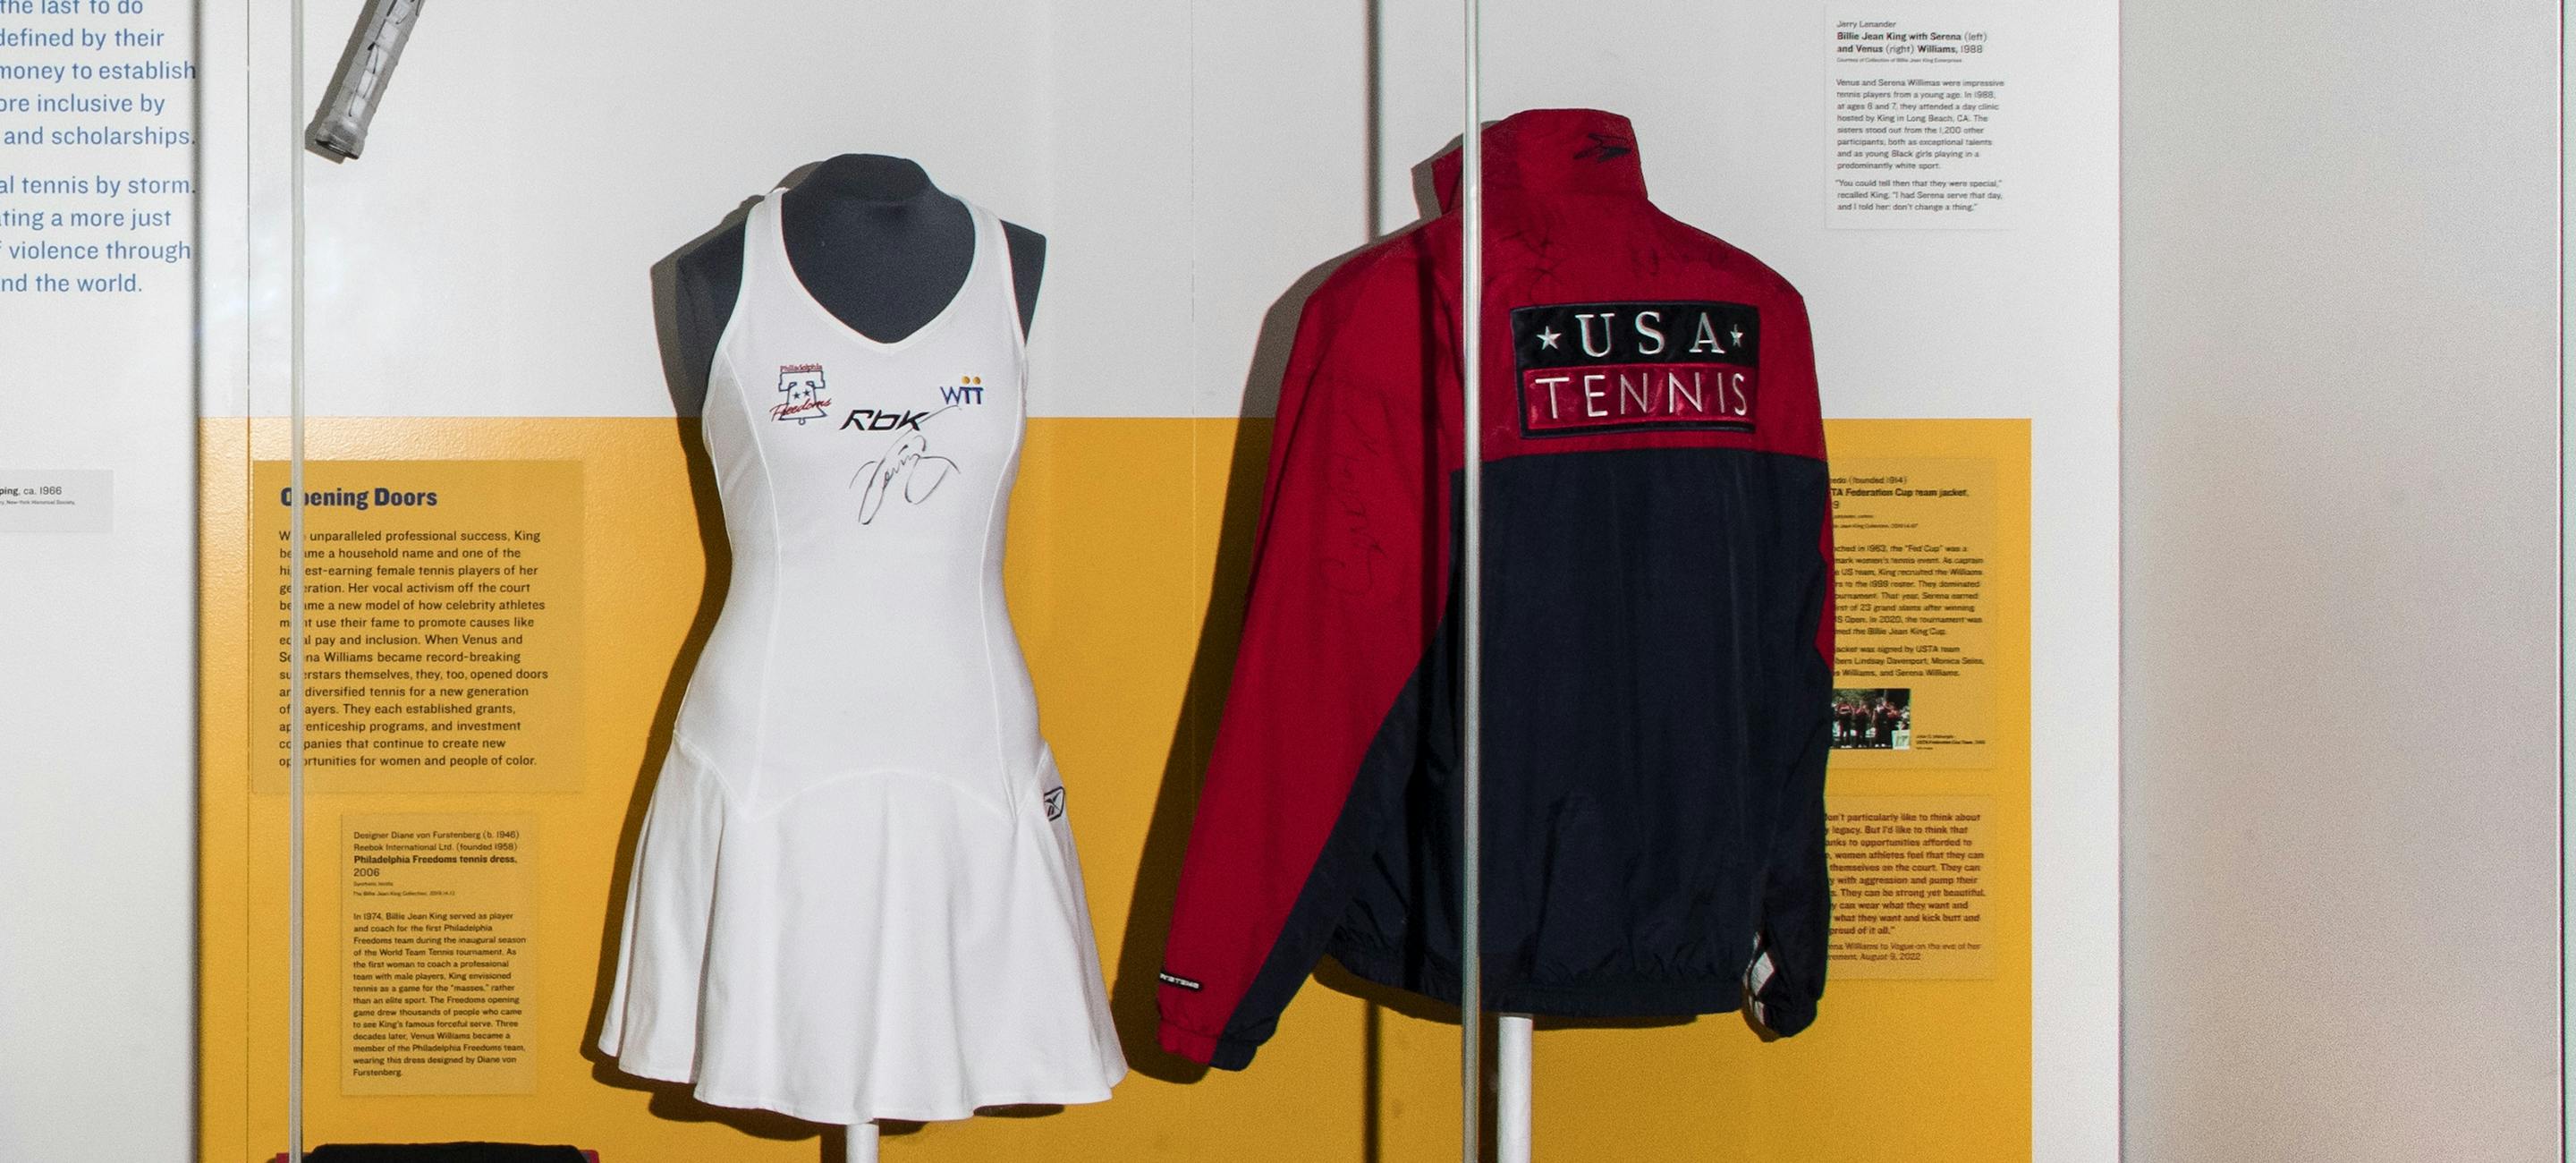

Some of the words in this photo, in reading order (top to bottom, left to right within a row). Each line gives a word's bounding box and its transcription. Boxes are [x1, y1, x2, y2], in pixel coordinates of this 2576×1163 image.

[0, 0, 33, 14] the
[42, 0, 80, 14] last
[89, 0, 110, 14] to
[118, 0, 143, 14] do
[82, 28, 106, 51] by
[114, 28, 165, 47] their
[1837, 31, 1860, 40] Billie
[1861, 32, 1884, 40] Jean
[1886, 32, 1907, 43] King
[1909, 32, 1928, 40] with
[1930, 32, 1962, 40] Serena
[1964, 32, 1987, 42] (left)
[1837, 45, 1853, 53] and
[1855, 45, 1883, 53] Venus
[1885, 45, 1914, 54] (right)
[1917, 45, 1958, 54] Williams,
[1961, 45, 1983, 54] 1988
[72, 64, 92, 80] to
[99, 62, 196, 80] establish
[0, 98, 30, 112] ore
[38, 93, 132, 112] inclusive
[140, 93, 165, 116] by
[4, 126, 43, 145] and
[52, 126, 196, 149] scholarships.
[21, 175, 89, 194] tennis
[97, 175, 121, 198] by
[128, 176, 196, 196] storm.
[3, 208, 44, 231] ting
[51, 213, 64, 226] a
[71, 213, 124, 227] more
[130, 208, 171, 231] just
[9, 241, 98, 259] violence
[106, 241, 191, 263] through
[36, 273, 69, 293] the
[77, 273, 142, 293] world.
[1575, 311, 1726, 357] USA
[1535, 371, 1748, 420] TENNIS
[39, 486, 62, 495] 1966
[374, 488, 437, 506] Doors
[309, 531, 382, 543] unparalleled
[386, 531, 457, 543] professional
[460, 532, 511, 541] success,
[514, 530, 541, 543] King
[280, 565, 373, 578] hiest-earning
[377, 565, 415, 576] female
[419, 565, 454, 576] tennis
[458, 565, 500, 578] players
[504, 565, 515, 575] of
[519, 565, 538, 575] her
[279, 582, 344, 595] geeration.
[348, 582, 369, 593] Her
[372, 582, 402, 593] vocal
[406, 582, 454, 593] activism
[458, 582, 474, 593] off
[478, 582, 496, 593] the
[499, 583, 530, 593] court
[327, 602, 335, 610] a
[338, 602, 362, 610] new
[365, 599, 400, 610] model
[402, 599, 415, 610] of
[419, 599, 443, 610] how
[445, 599, 496, 612] celebrity
[498, 599, 546, 610] athletes
[279, 651, 320, 663] Sena
[324, 651, 373, 662] Williams
[377, 651, 422, 662] became
[426, 651, 521, 664] record-breaking
[279, 671, 342, 680] suerstars
[344, 669, 412, 680] themselves,
[416, 668, 443, 682] they,
[446, 670, 468, 680] too,
[470, 668, 513, 681] opened
[515, 668, 548, 679] doors
[279, 721, 366, 734] apenticeship
[369, 723, 428, 734] programs,
[431, 720, 453, 731] and
[457, 721, 521, 731] investment
[353, 831, 389, 840] Designer
[391, 831, 414, 839] Diane
[433, 830, 481, 840] Furstenberg
[353, 844, 384, 852] Reebok
[456, 842, 493, 852] (founded
[495, 842, 518, 852] 1958)
[354, 855, 411, 865] Philadelphia
[412, 854, 457, 863] Freedoms
[459, 854, 487, 863] tennis
[353, 868, 380, 877] 2006
